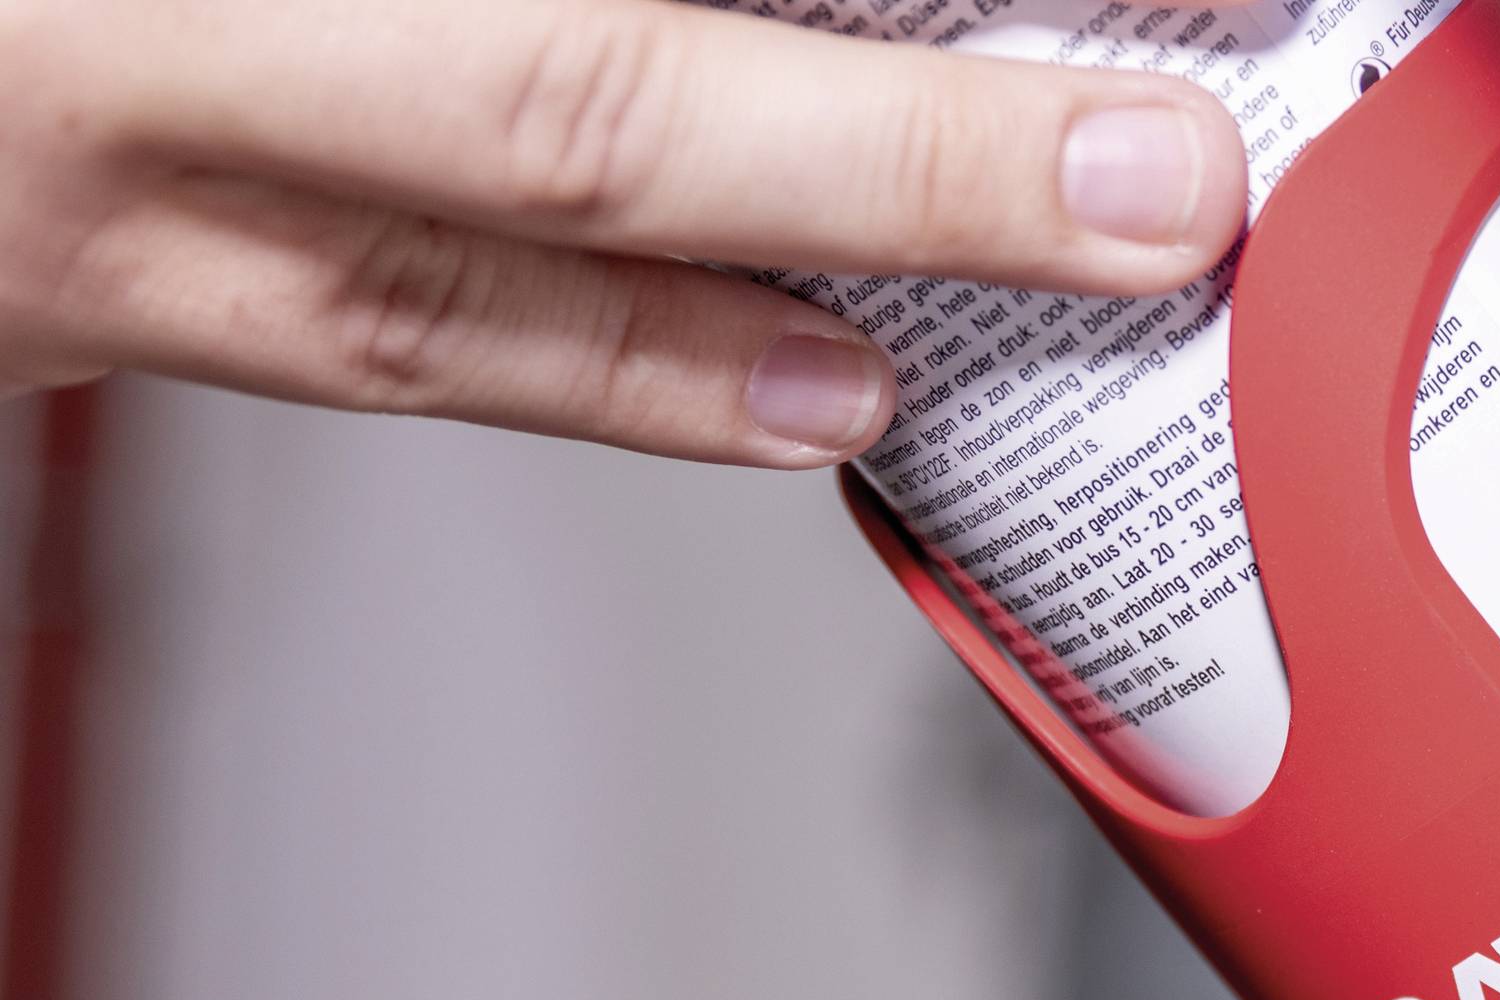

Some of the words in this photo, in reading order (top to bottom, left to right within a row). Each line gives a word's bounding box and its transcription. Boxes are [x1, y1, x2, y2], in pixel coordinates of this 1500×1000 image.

[1174, 8, 1218, 48] water
[1386, 22, 1412, 48] Für
[1404, 0, 1440, 28] Deuts
[1236, 57, 1260, 82] en
[1280, 104, 1300, 131] of
[831, 294, 848, 316] of
[886, 316, 943, 356] warmte,
[936, 288, 977, 320] hete
[896, 362, 925, 390] Niet
[924, 334, 973, 371] roken.
[970, 301, 1011, 335] Niet
[1008, 288, 1033, 307] in
[904, 381, 953, 419] Houder
[954, 351, 996, 388] onder
[997, 321, 1040, 359] druk:
[1039, 296, 1075, 328] ook
[918, 417, 959, 445] tegen
[960, 402, 982, 423] de
[983, 380, 1016, 407] zon
[1018, 360, 1043, 383] en
[1045, 330, 1081, 364] niet
[953, 372, 1083, 463] Inhoud/verpakking
[1081, 300, 1178, 376] verwijderen
[974, 467, 996, 488] en
[993, 408, 1085, 478] internationale
[1081, 349, 1170, 416] wetgeving.
[1164, 303, 1221, 352] Bevat
[1413, 339, 1484, 410] wijderen
[1409, 385, 1480, 452] omkeren
[960, 492, 1009, 531] toxiciteit
[1004, 476, 1035, 506] niet
[1027, 445, 1083, 491] bekend
[1078, 438, 1104, 456] is.
[1053, 414, 1197, 515] herpositionering
[997, 546, 1056, 584] schudden
[1052, 525, 1089, 556] voor
[1088, 485, 1154, 537] gebruik.
[1149, 445, 1200, 489] Draai
[1201, 430, 1226, 454] de
[1008, 592, 1038, 612] bus.
[1030, 569, 1074, 601] Houdt
[1071, 561, 1092, 581] de
[1086, 542, 1121, 570] bus
[1118, 525, 1142, 549] 15
[1149, 504, 1174, 529] 20
[1174, 487, 1204, 512] cm
[1202, 461, 1238, 491] van
[1032, 601, 1086, 635] eenzijdig
[1082, 585, 1115, 611] aan.
[1112, 558, 1152, 590] Laat
[1150, 541, 1175, 566] 20
[1189, 513, 1216, 539] 30
[1050, 632, 1091, 658] daarna
[1089, 621, 1110, 640] de
[1108, 574, 1191, 630] verbinding
[1189, 534, 1252, 580] maken.
[1137, 622, 1172, 649] Aan
[1167, 602, 1200, 630] het
[1199, 574, 1238, 611] eind
[1112, 676, 1137, 698] van
[1129, 664, 1162, 689] lijm
[1154, 655, 1180, 674] is.
[1132, 685, 1178, 720] vooraf
[1171, 657, 1226, 700] testen!
